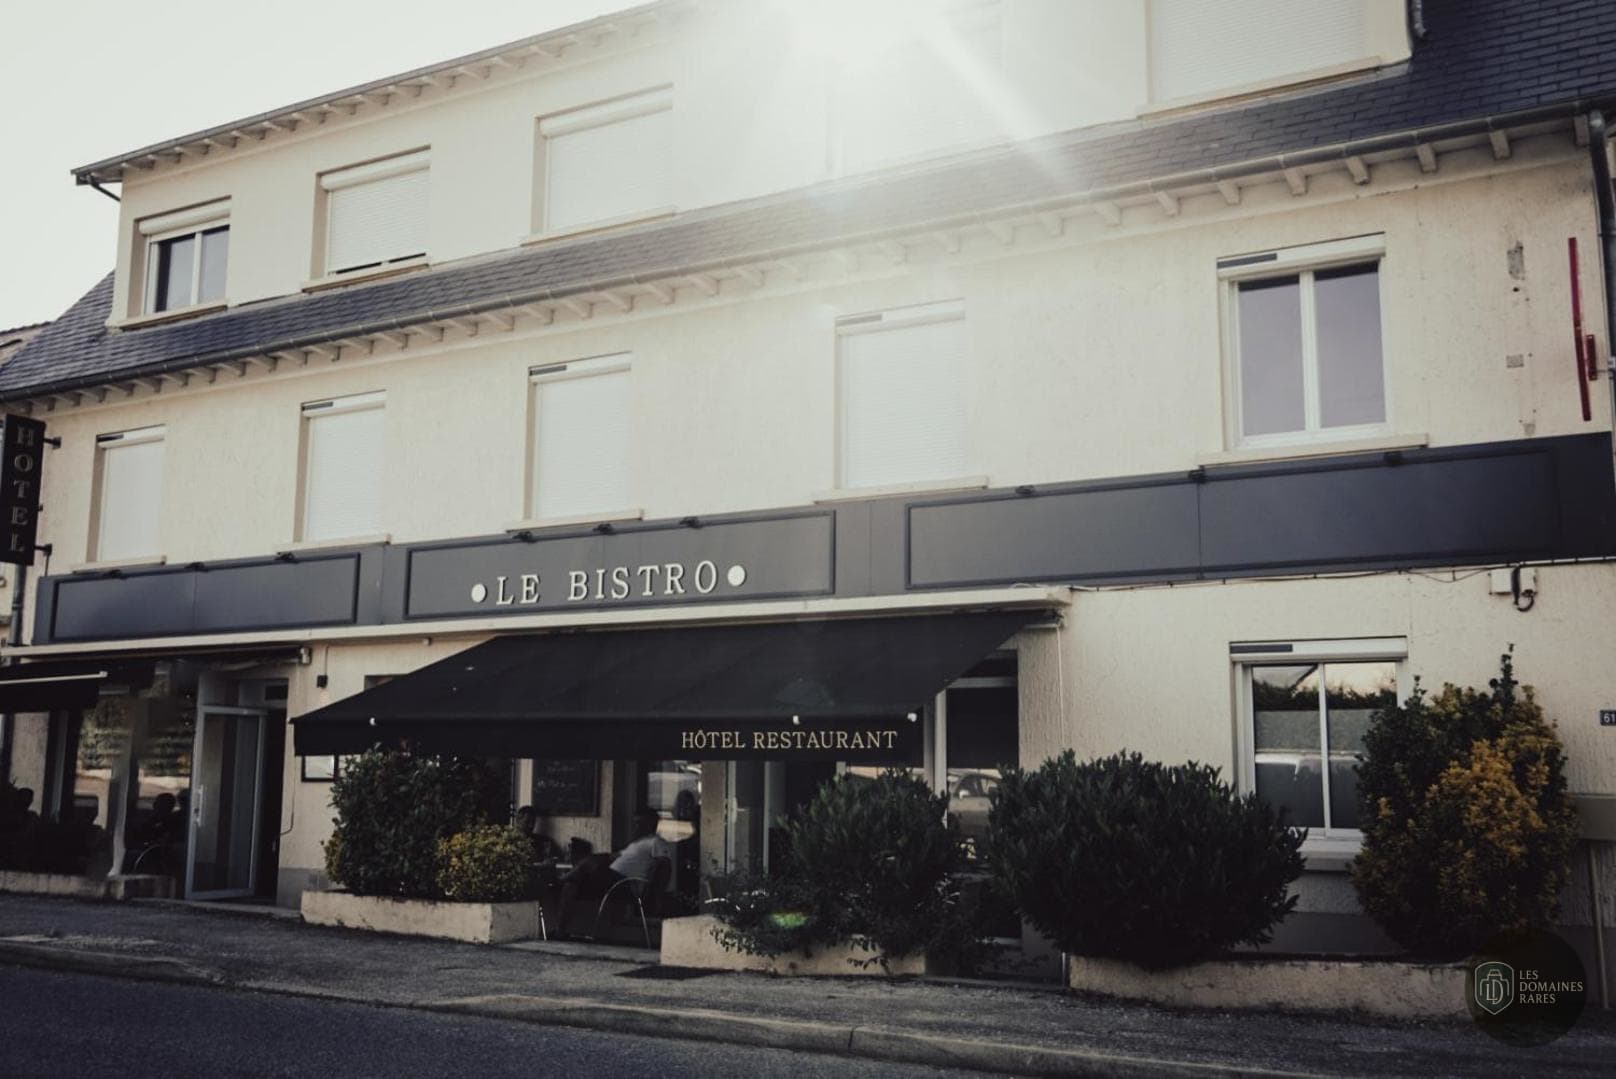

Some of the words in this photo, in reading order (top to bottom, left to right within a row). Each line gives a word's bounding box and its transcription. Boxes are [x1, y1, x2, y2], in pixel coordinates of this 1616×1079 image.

[10, 426, 34, 552] HOTEL
[495, 573, 541, 606] LE
[567, 559, 718, 601] BISTRO
[681, 729, 746, 749] HÔTEL
[752, 730, 898, 749] RESTAURANT
